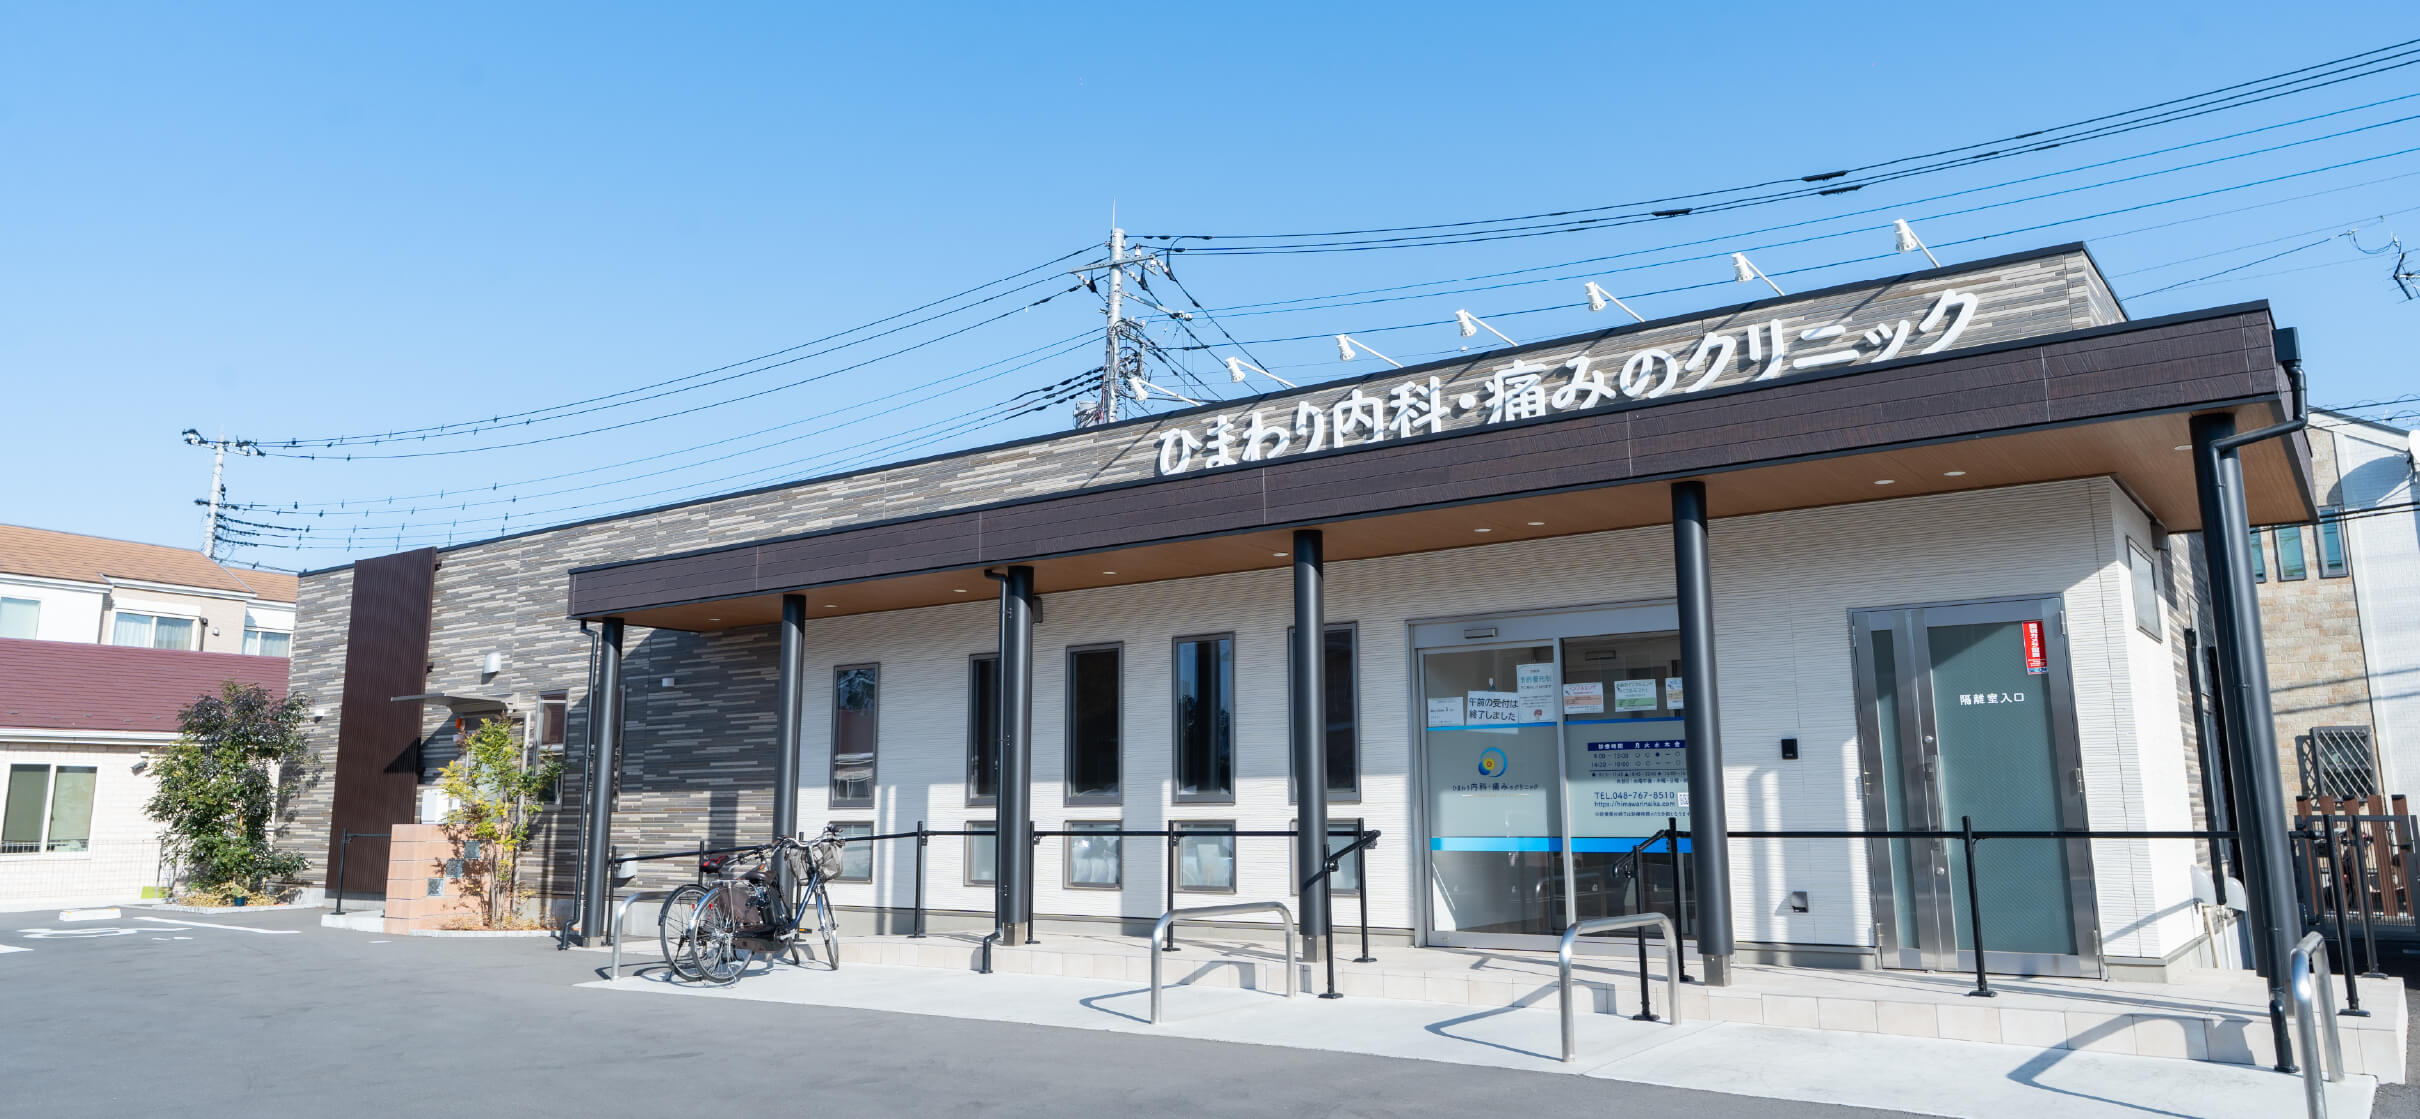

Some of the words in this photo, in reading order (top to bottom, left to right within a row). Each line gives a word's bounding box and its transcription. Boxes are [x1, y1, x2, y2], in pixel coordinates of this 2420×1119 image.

[1158, 288, 1979, 476] ひまわり内科・痛みのクリニック
[1468, 697, 1519, 709] 午前の受付は
[1959, 692, 2025, 706] 隔離室入口
[1469, 710, 1516, 721] 終了しました
